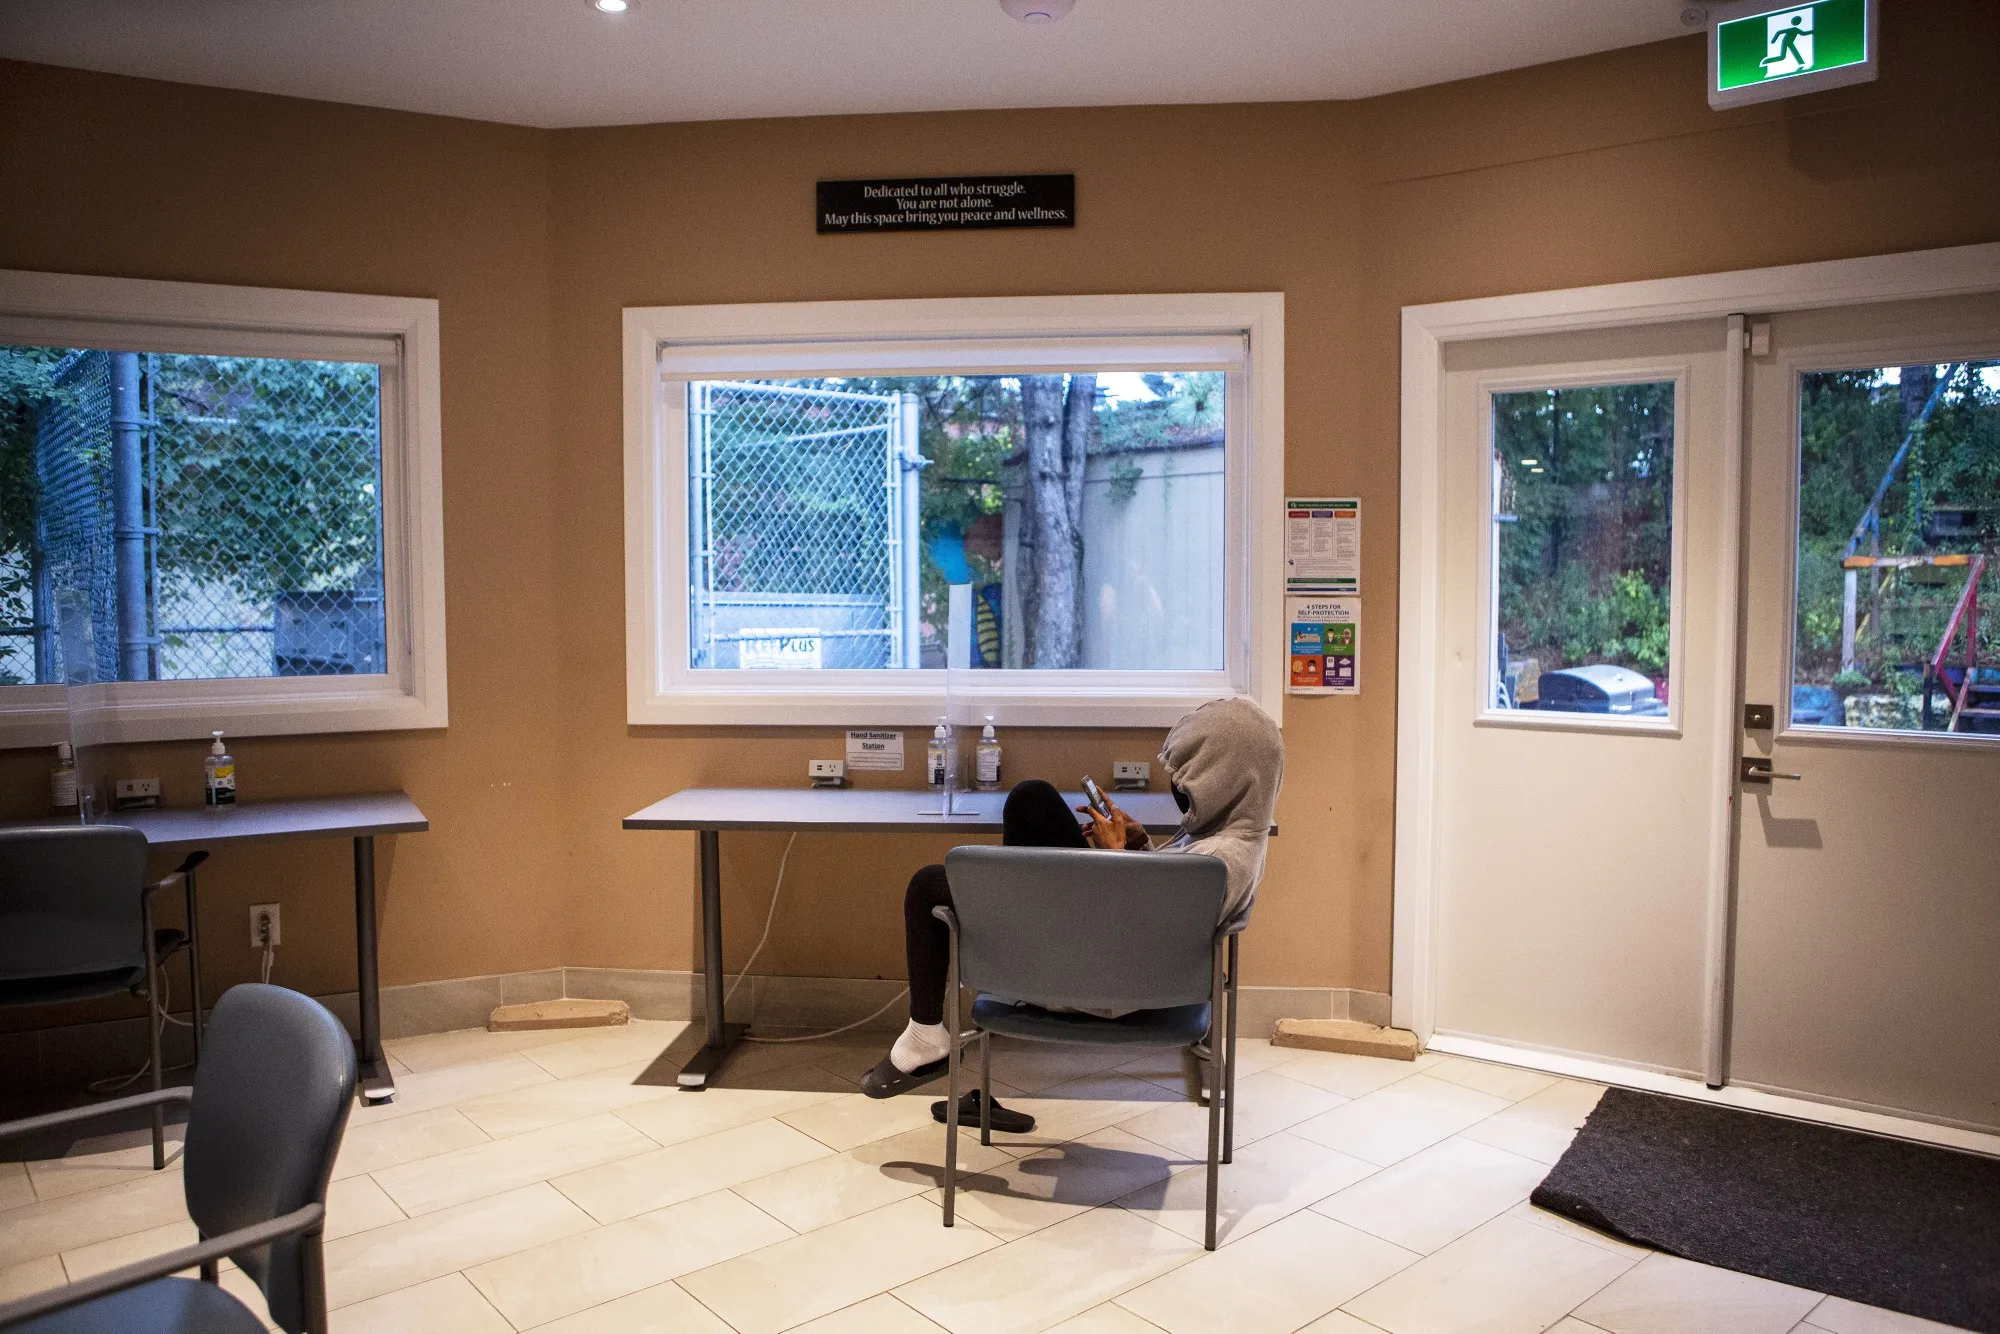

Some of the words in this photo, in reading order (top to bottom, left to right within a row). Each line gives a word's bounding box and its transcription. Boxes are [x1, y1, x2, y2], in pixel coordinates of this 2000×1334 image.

[864, 184, 918, 198] Dedicated
[920, 185, 932, 196] to
[934, 183, 948, 196] all
[950, 183, 974, 195] who
[976, 181, 1026, 197] struggle.
[896, 198, 917, 210] You
[919, 199, 937, 209] are
[939, 197, 959, 209] not
[960, 196, 994, 208] alone.
[824, 213, 849, 227] May
[851, 211, 872, 224] this
[873, 212, 904, 226] space
[905, 210, 937, 225] bring
[938, 211, 959, 225] you
[960, 211, 992, 224] peace
[994, 207, 1016, 220] and
[1017, 207, 1068, 220] wellness.
[868, 732, 897, 740] Sanitizer
[862, 742, 885, 750] Station
